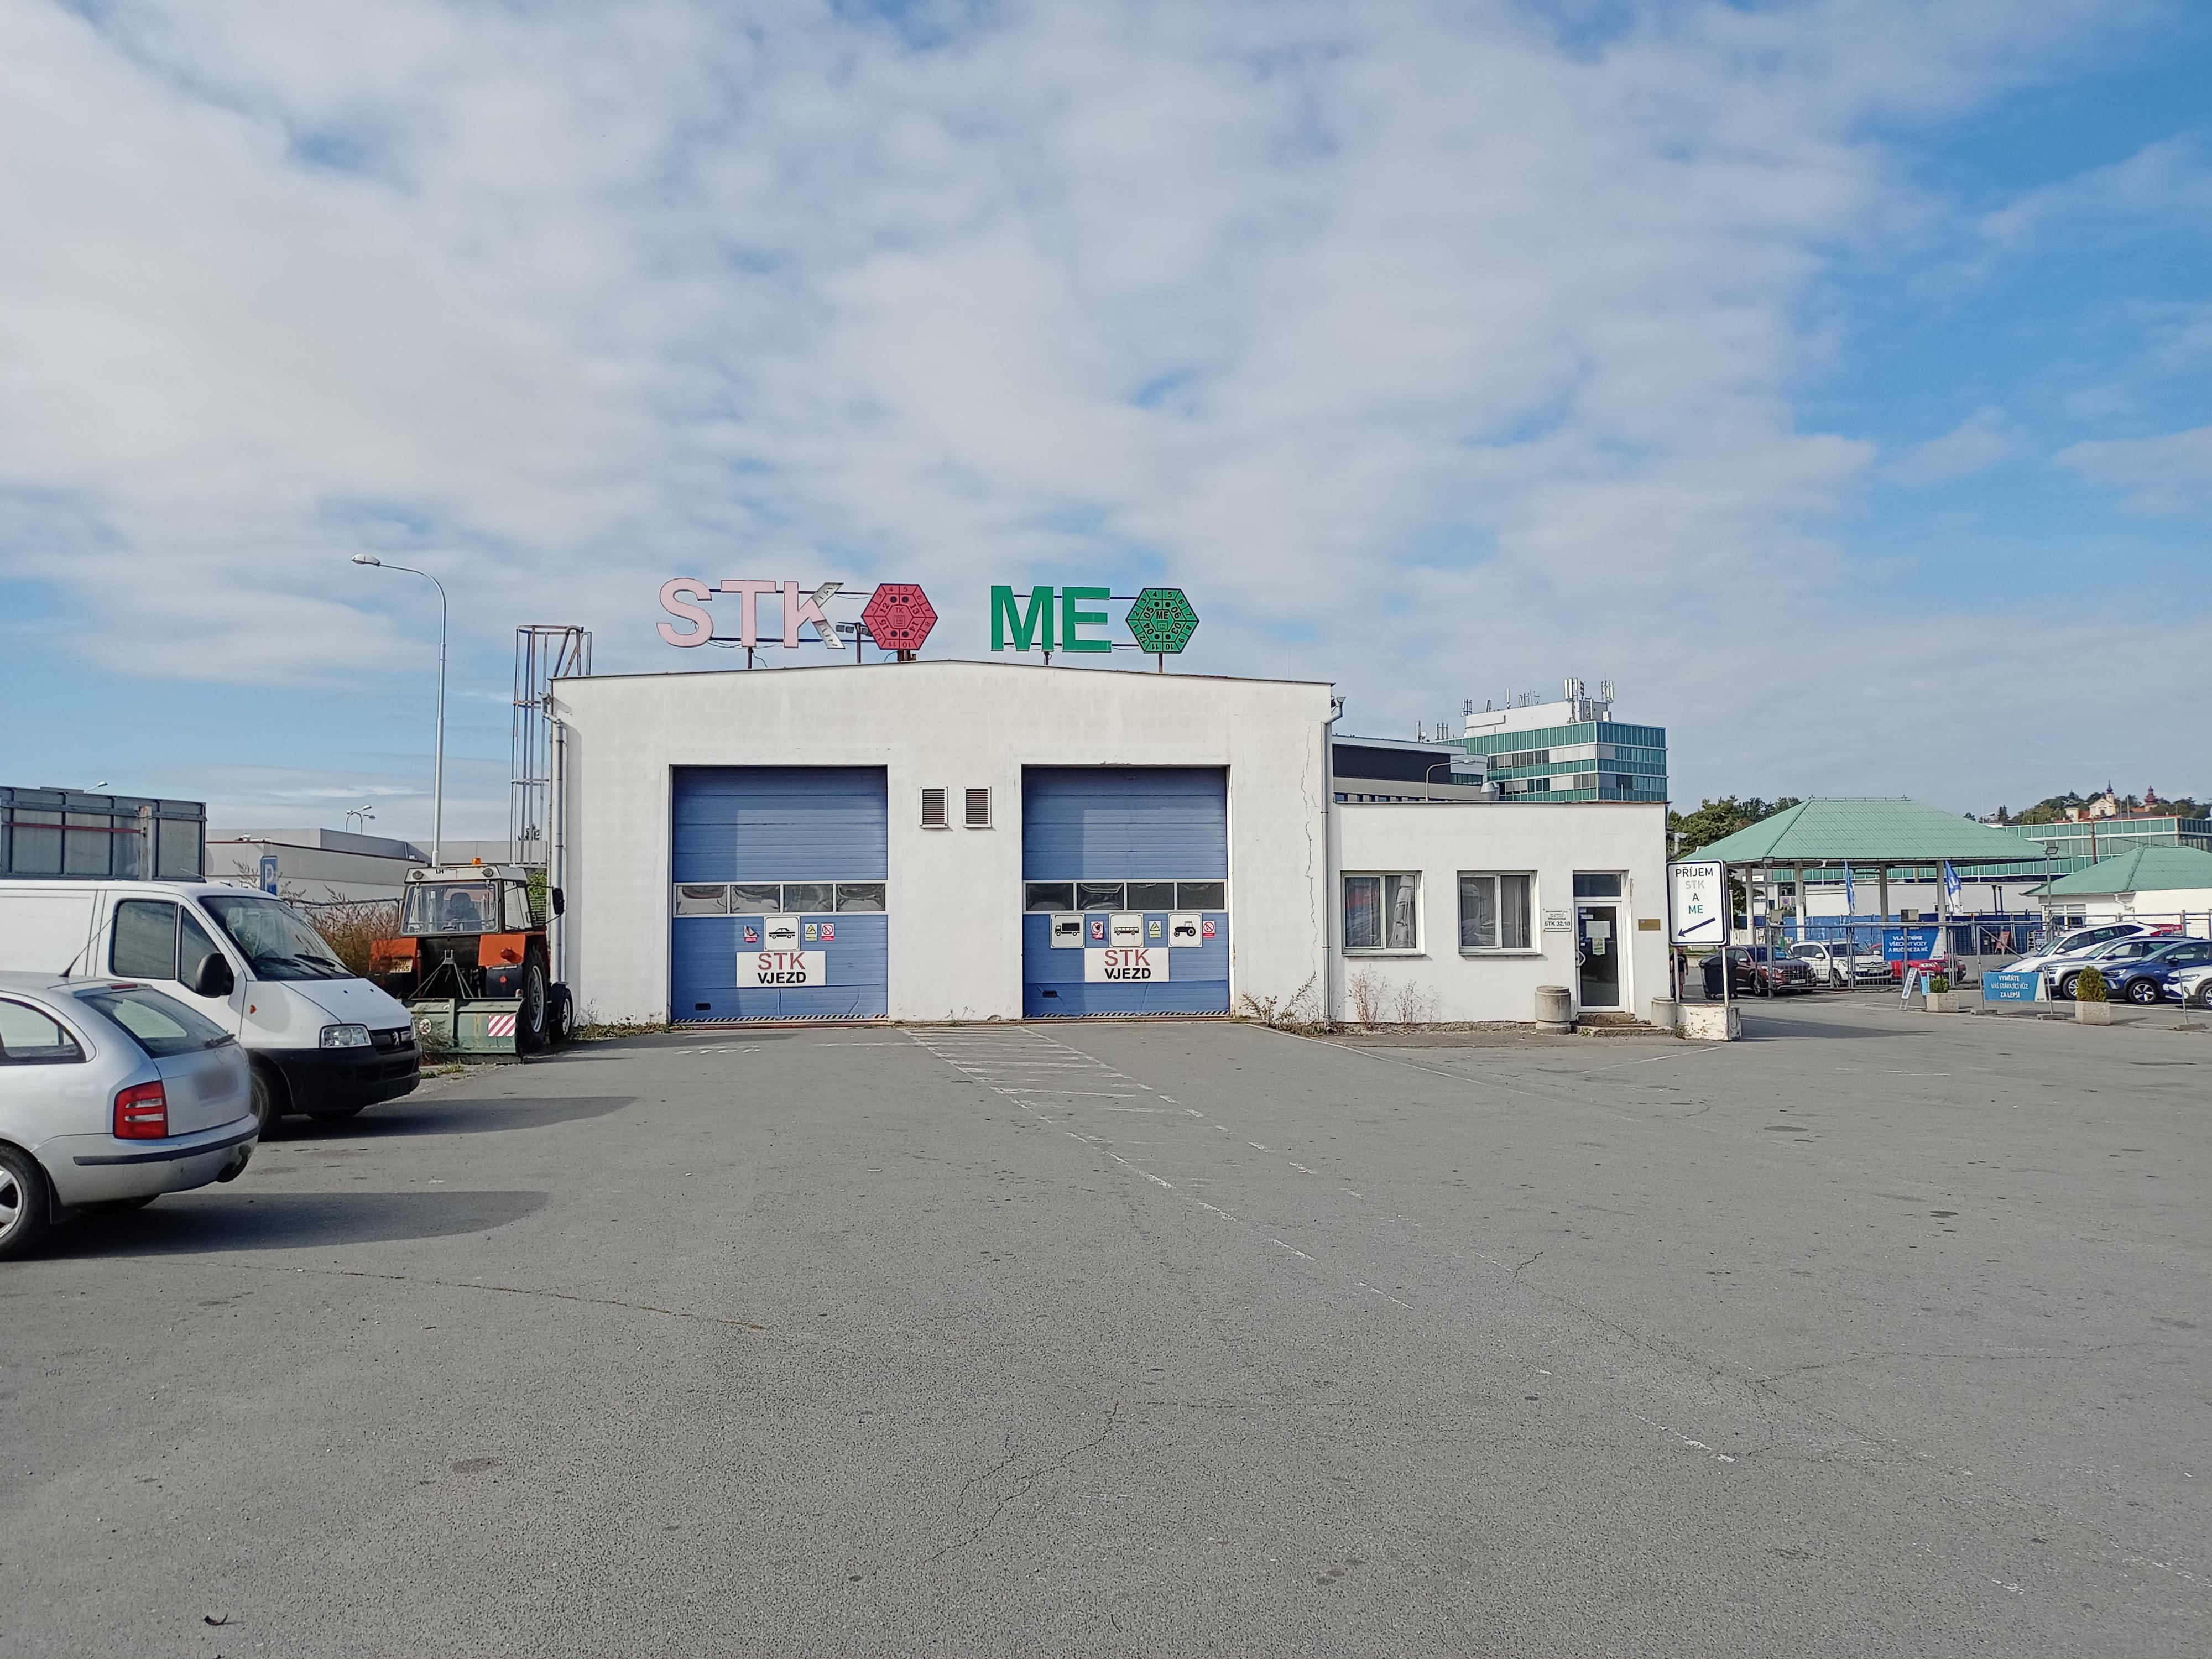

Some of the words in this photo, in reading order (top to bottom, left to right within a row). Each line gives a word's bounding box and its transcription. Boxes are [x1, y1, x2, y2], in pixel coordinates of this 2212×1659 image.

[656, 577, 845, 649] STK
[880, 602, 890, 613] 12
[910, 603, 920, 615] 13
[1144, 606, 1154, 619] 05
[1171, 606, 1181, 619] 06
[991, 585, 1112, 653] ME
[1156, 611, 1168, 619] ME
[879, 619, 889, 630] 15
[909, 621, 919, 633] 14
[1144, 623, 1154, 635] 04
[1172, 623, 1181, 634] 03
[875, 632, 884, 641] 12
[1140, 635, 1147, 644] 12
[1676, 866, 1713, 877] PŘÍJEM
[265, 864, 274, 891] P
[1685, 880, 1704, 889] STK
[1692, 893, 1699, 901] A
[1688, 905, 1703, 914] ME
[758, 952, 806, 970] STK
[1104, 949, 1150, 966] STK
[758, 972, 806, 984] VJEZD
[1104, 968, 1151, 979] VJEZD
